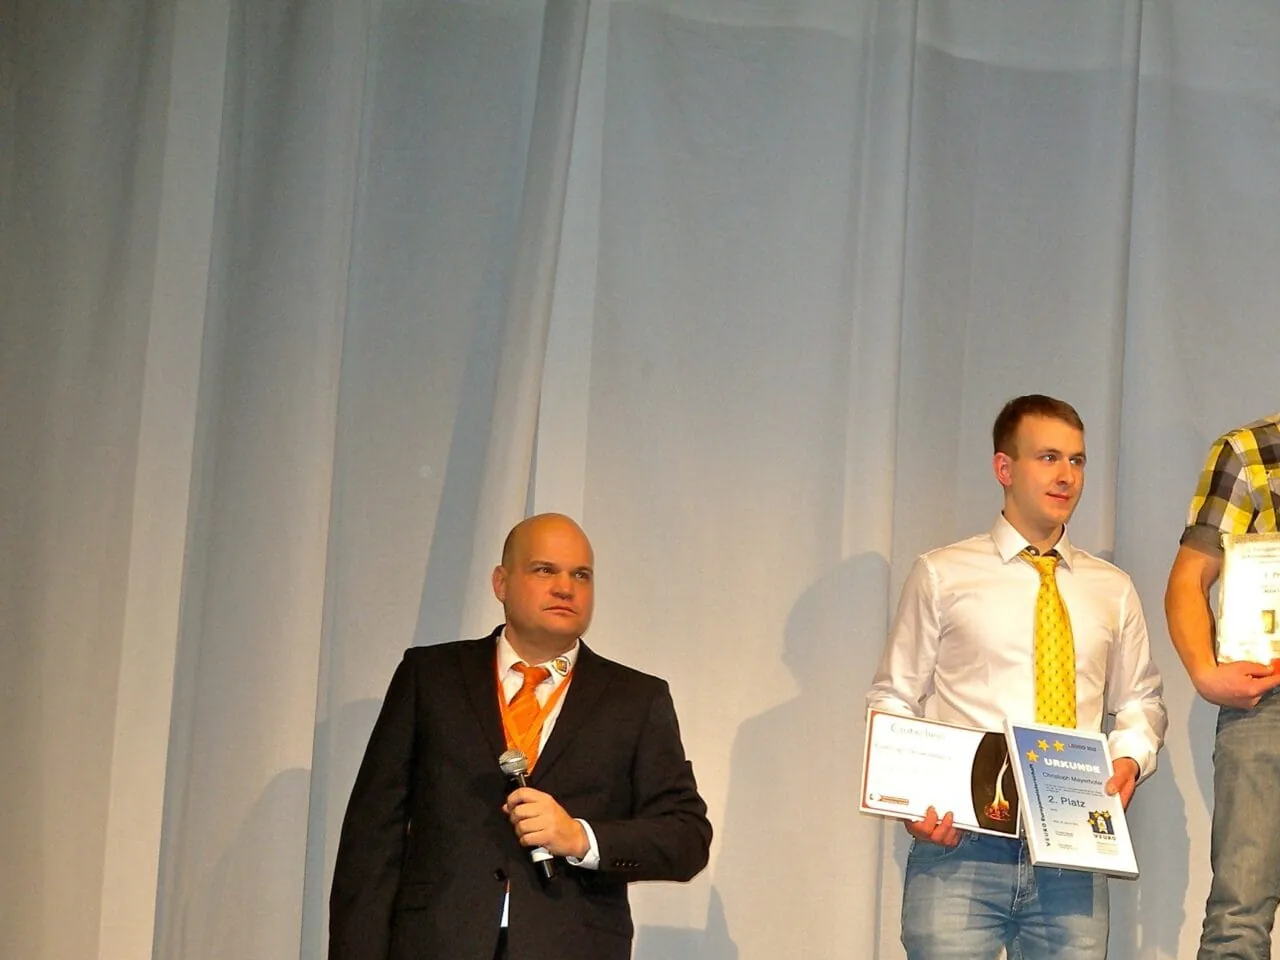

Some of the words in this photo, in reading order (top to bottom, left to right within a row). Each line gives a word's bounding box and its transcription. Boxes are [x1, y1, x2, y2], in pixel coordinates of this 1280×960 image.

[1044, 757, 1101, 774] URKUNDE
[1048, 795, 1058, 804] 2.
[1061, 796, 1086, 808] Platz
